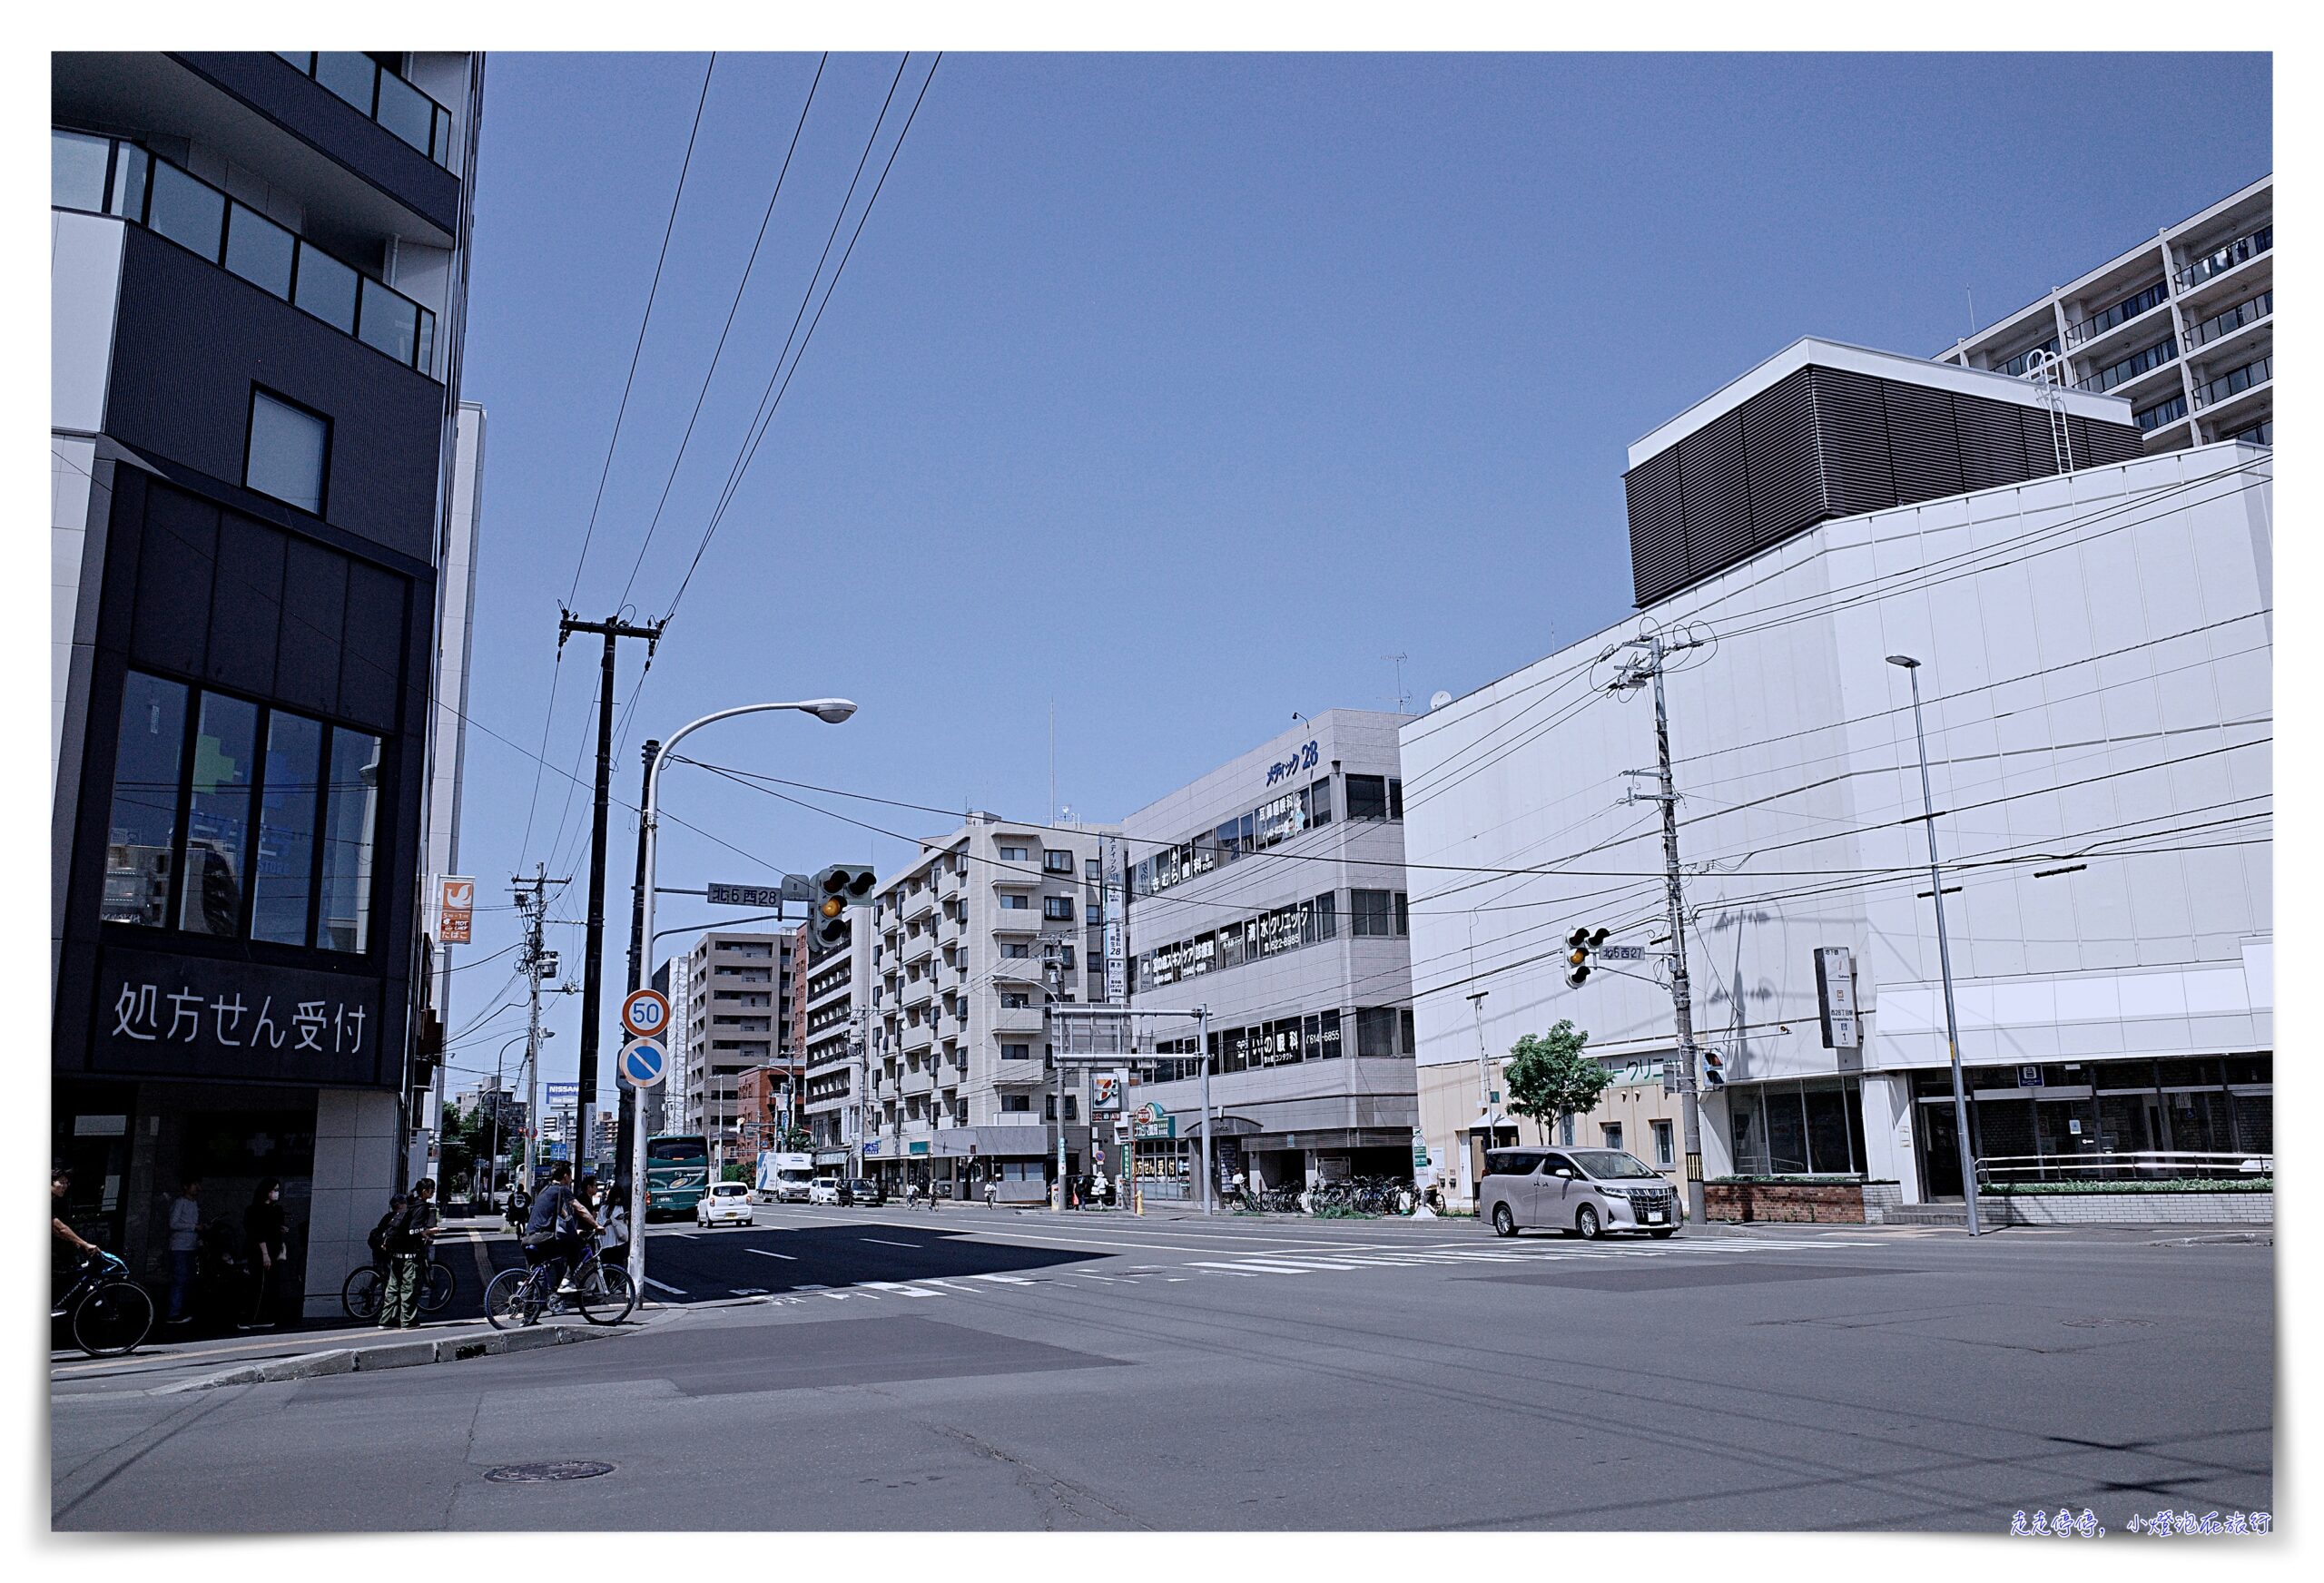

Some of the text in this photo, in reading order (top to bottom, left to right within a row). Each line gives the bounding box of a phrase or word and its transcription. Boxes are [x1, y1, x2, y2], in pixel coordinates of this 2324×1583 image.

[1266, 740, 1319, 788] メディック 28
[441, 930, 468, 939] たばこ
[1247, 907, 1308, 943] 清水クリニック
[1110, 948, 1121, 956] 28
[112, 981, 367, 1054] 処方せん受付
[632, 1003, 660, 1024] 50
[1252, 1030, 1298, 1056] いの眼科
[1842, 1032, 1846, 1041] 1
